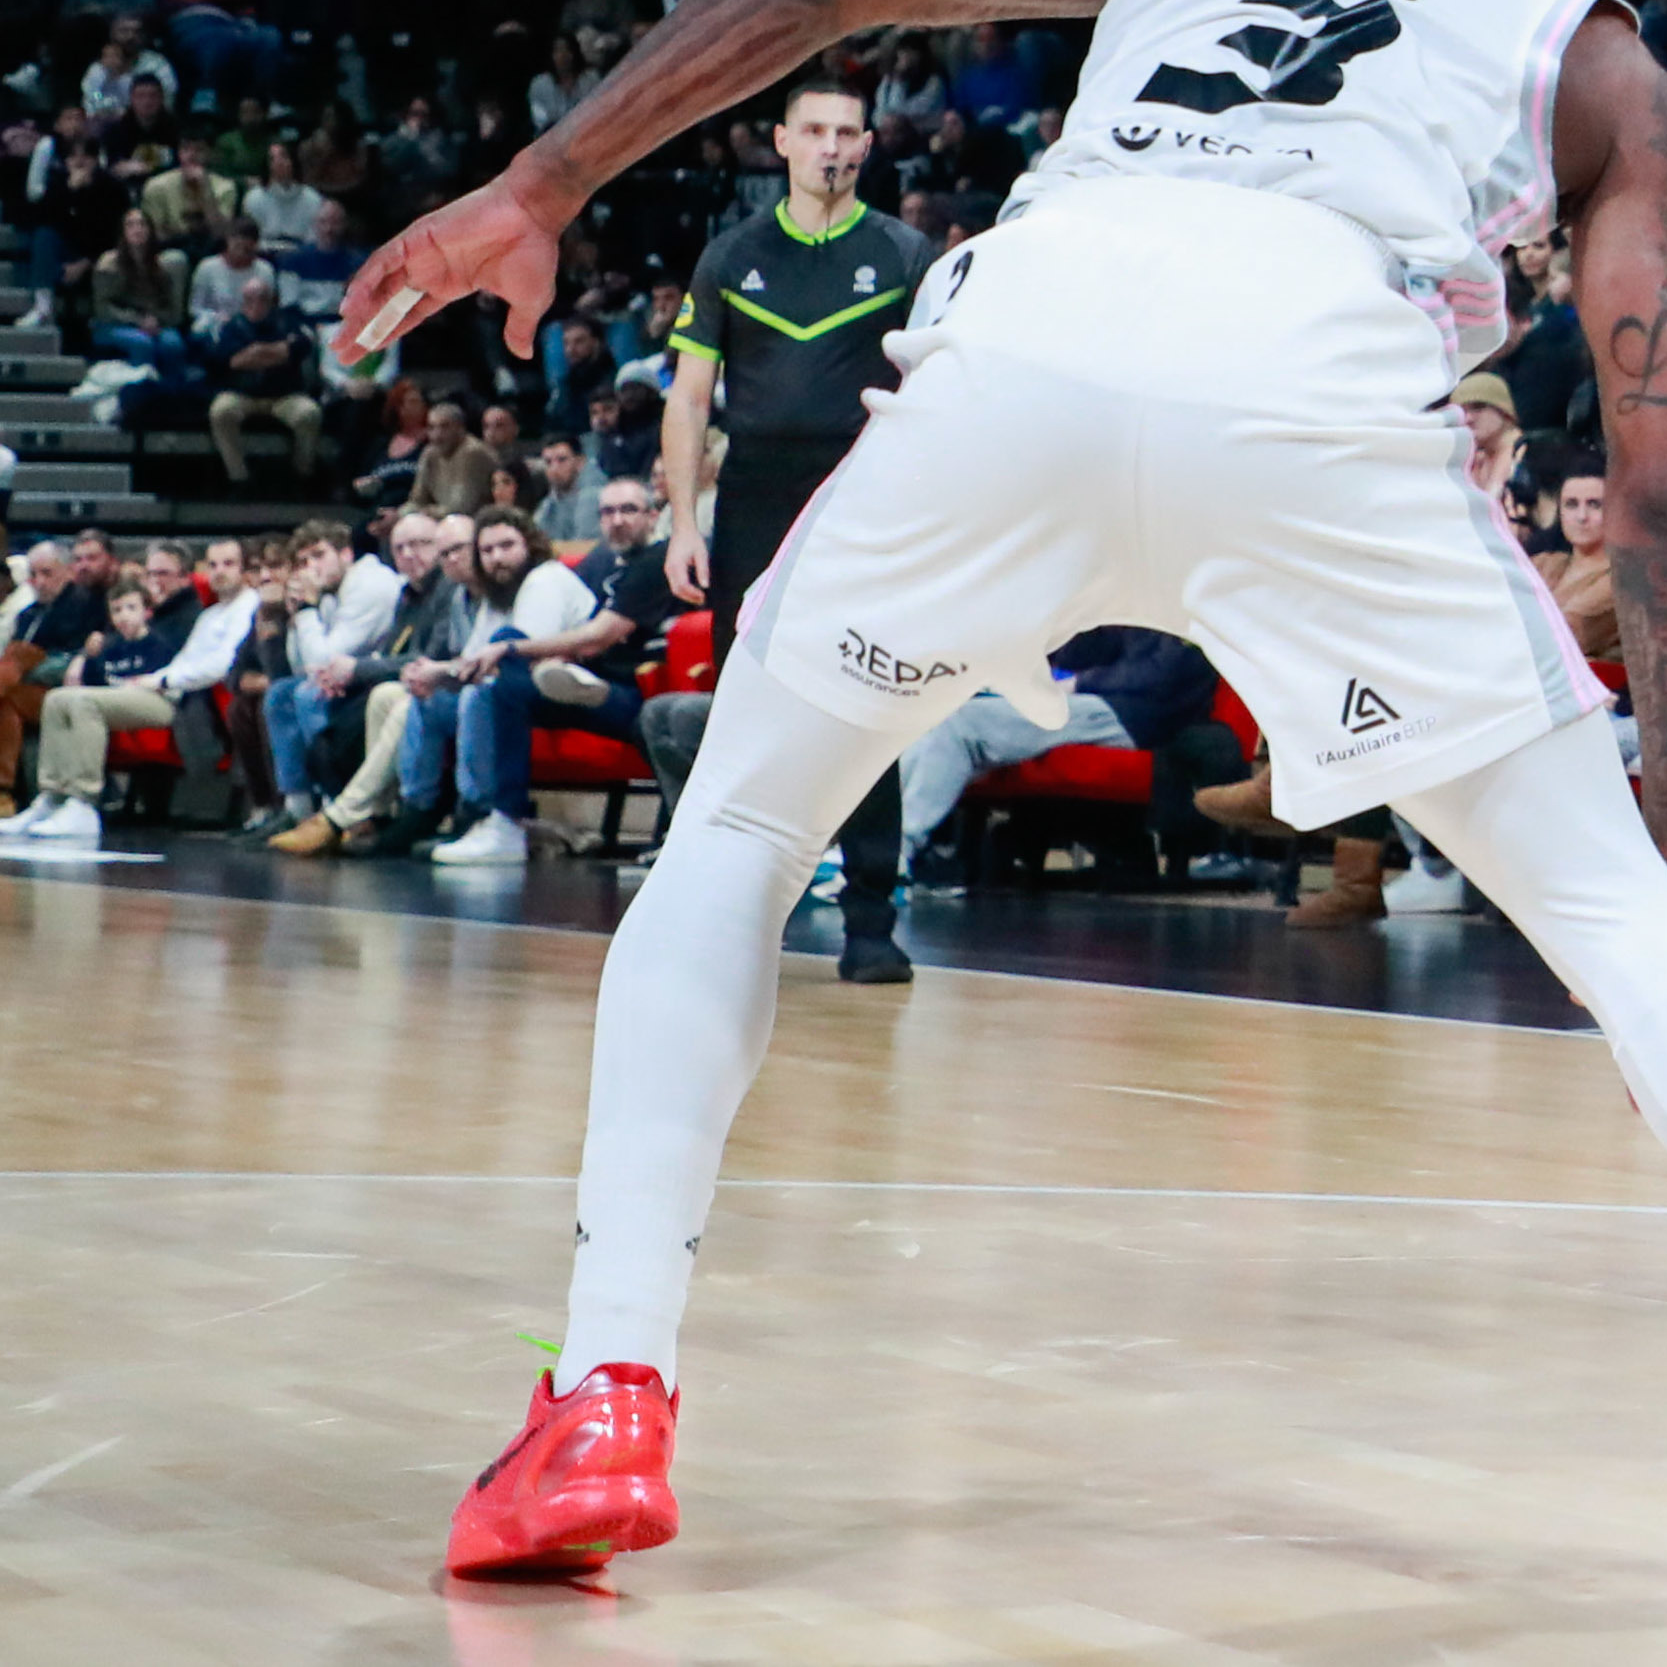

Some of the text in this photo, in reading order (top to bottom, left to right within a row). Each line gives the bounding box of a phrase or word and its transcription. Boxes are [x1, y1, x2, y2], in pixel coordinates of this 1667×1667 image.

[838, 627, 968, 684] REPA
[840, 664, 920, 697] assurances
[1315, 731, 1401, 767] l'Auxiliaire
